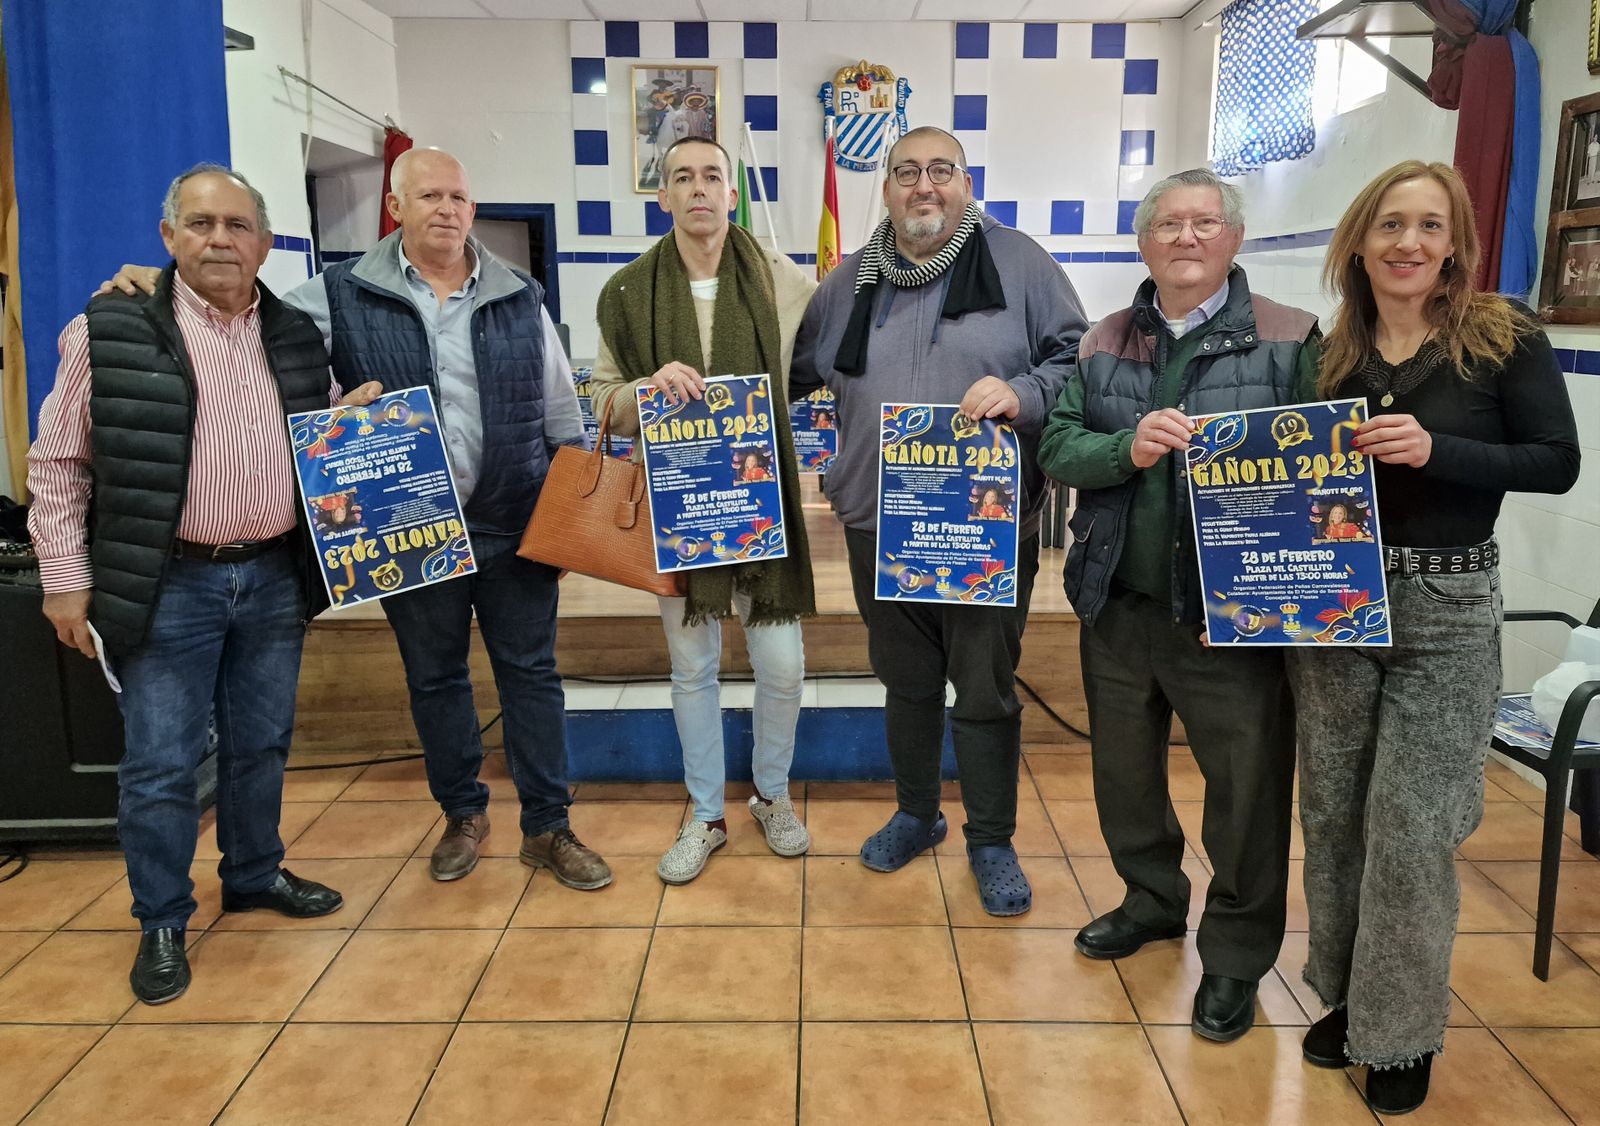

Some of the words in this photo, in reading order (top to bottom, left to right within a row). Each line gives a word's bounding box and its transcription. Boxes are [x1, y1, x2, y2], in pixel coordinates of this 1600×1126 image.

[842, 159, 850, 168] LA
[710, 389, 724, 402] 19
[646, 418, 717, 443] GAÑOTA
[722, 413, 769, 435] 2023
[1278, 419, 1298, 435] 19
[385, 453, 406, 462] PLAZA
[884, 441, 958, 465] GAÑOTA
[964, 447, 1015, 466] 2023
[337, 461, 372, 473] CASTILLITO
[382, 464, 395, 474] DE
[396, 460, 412, 472] 28
[1193, 456, 1289, 486] GAÑOTA
[1295, 450, 1365, 479] 2023
[335, 467, 382, 484] FEBRERO
[682, 493, 696, 504] 28
[697, 493, 708, 502] DE
[709, 488, 749, 501] FEBRERO
[911, 521, 926, 532] 28
[927, 523, 939, 532] DE
[941, 522, 983, 534] FEBRERO
[382, 518, 464, 553] GAÑOTA
[324, 538, 379, 568] 2023
[1240, 551, 1259, 564] 28
[1261, 552, 1276, 563] DE
[1278, 549, 1335, 562] FEBRERO
[1245, 565, 1271, 573] PLAZA
[1287, 562, 1332, 572] CASTILLITO
[381, 570, 396, 585] 19
